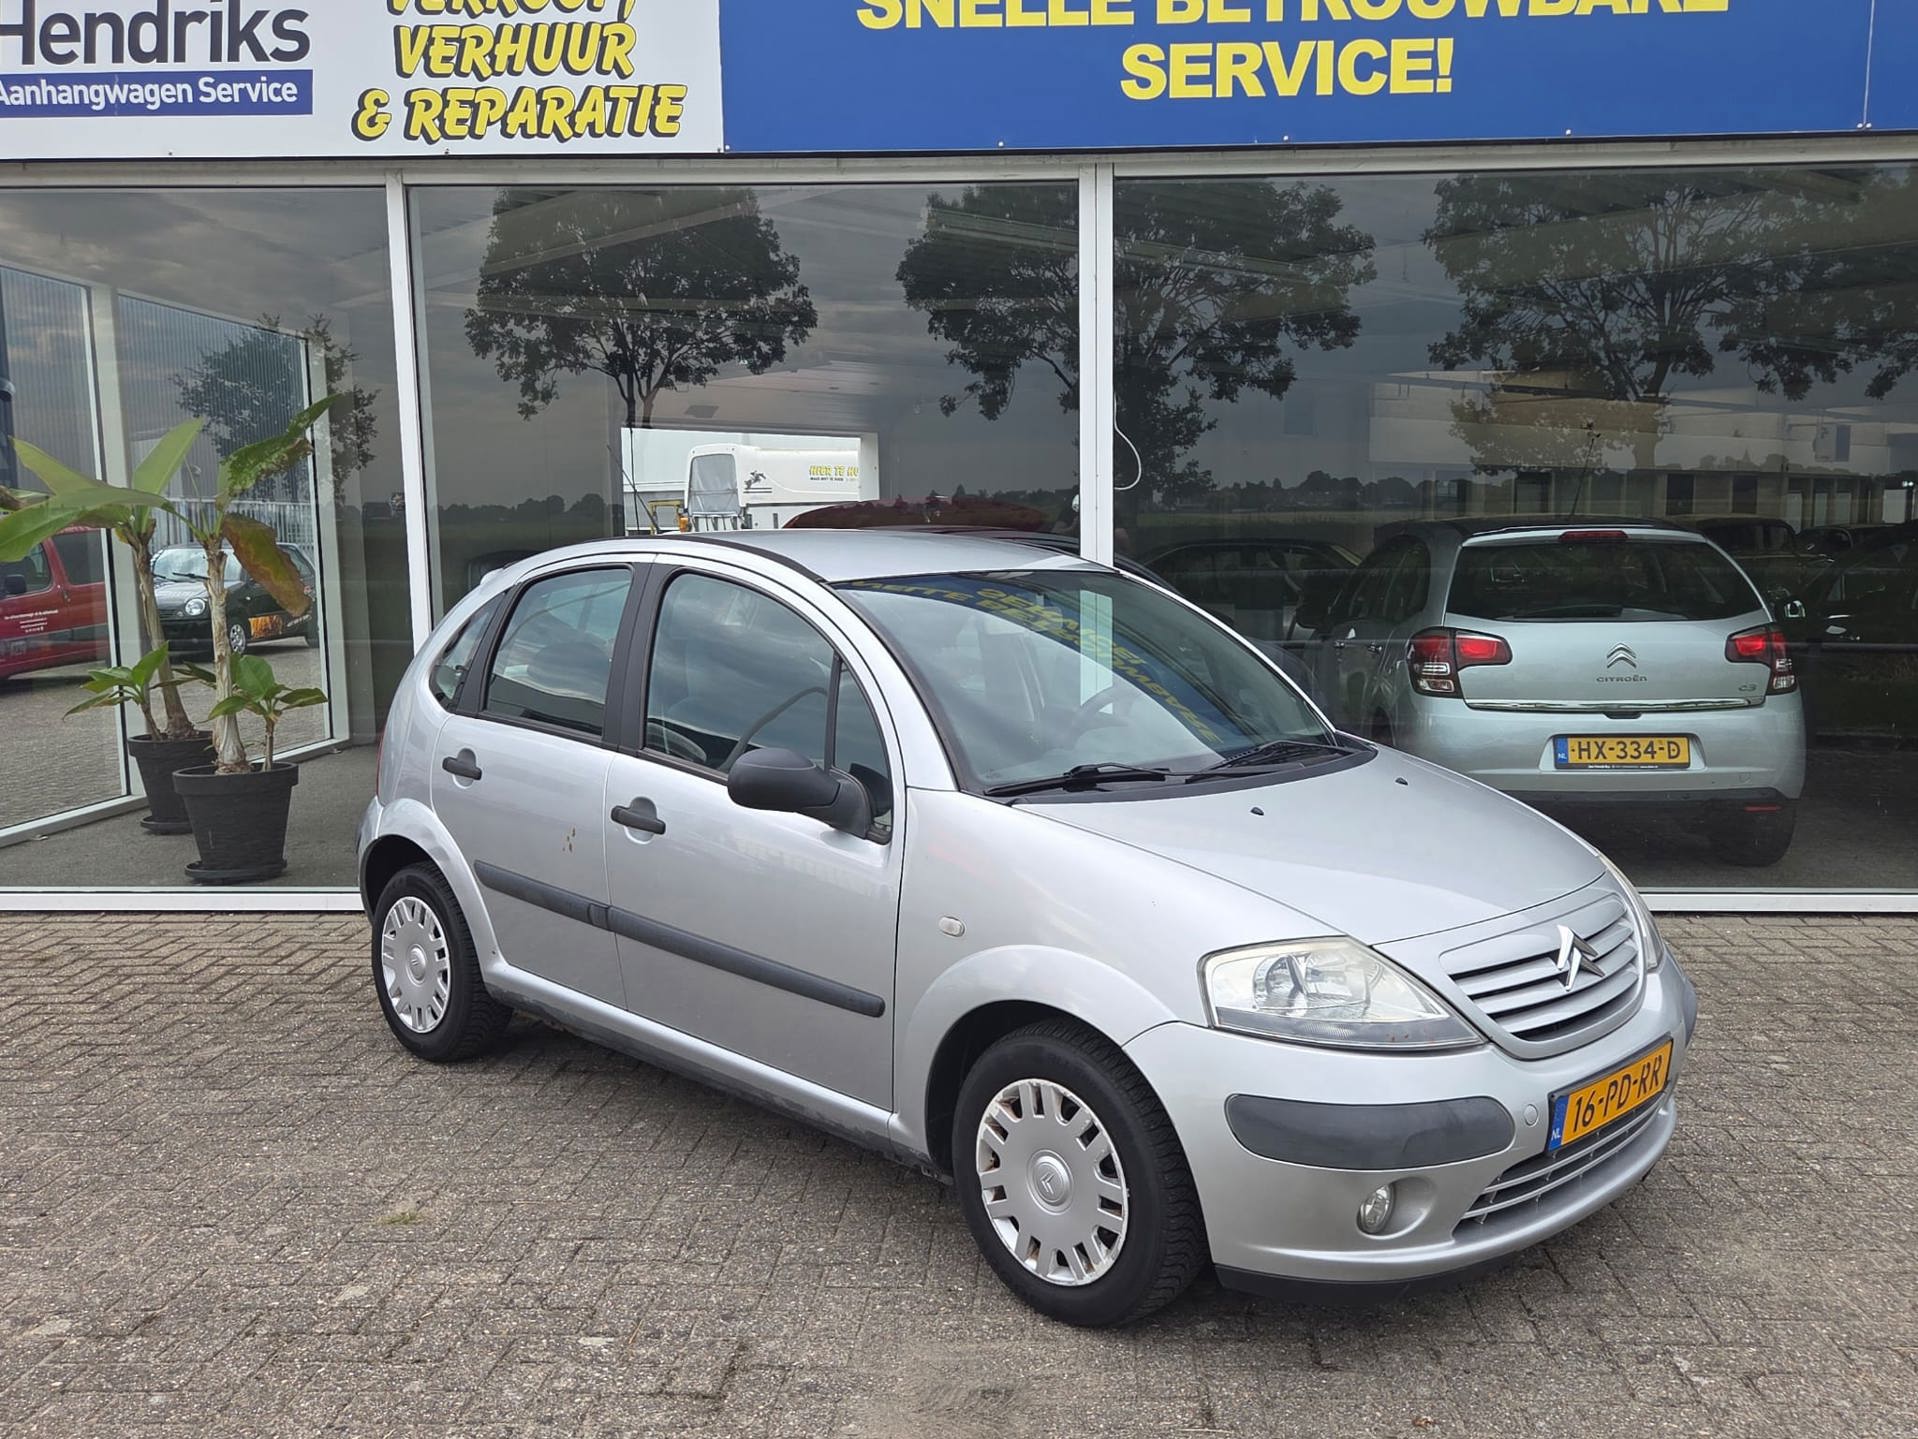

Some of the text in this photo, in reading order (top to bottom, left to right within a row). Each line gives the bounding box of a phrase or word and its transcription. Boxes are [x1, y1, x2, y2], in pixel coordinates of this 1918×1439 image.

[0, 0, 310, 65] Hendriks
[393, 22, 636, 81] VERHUUR
[198, 76, 298, 103] Service
[1120, 38, 1454, 100] SERVICE!
[351, 84, 687, 145] & REPARATIE
[1577, 740, 1681, 760] HX-334-D
[1551, 1054, 1662, 1142] NL 16-PD-RR
